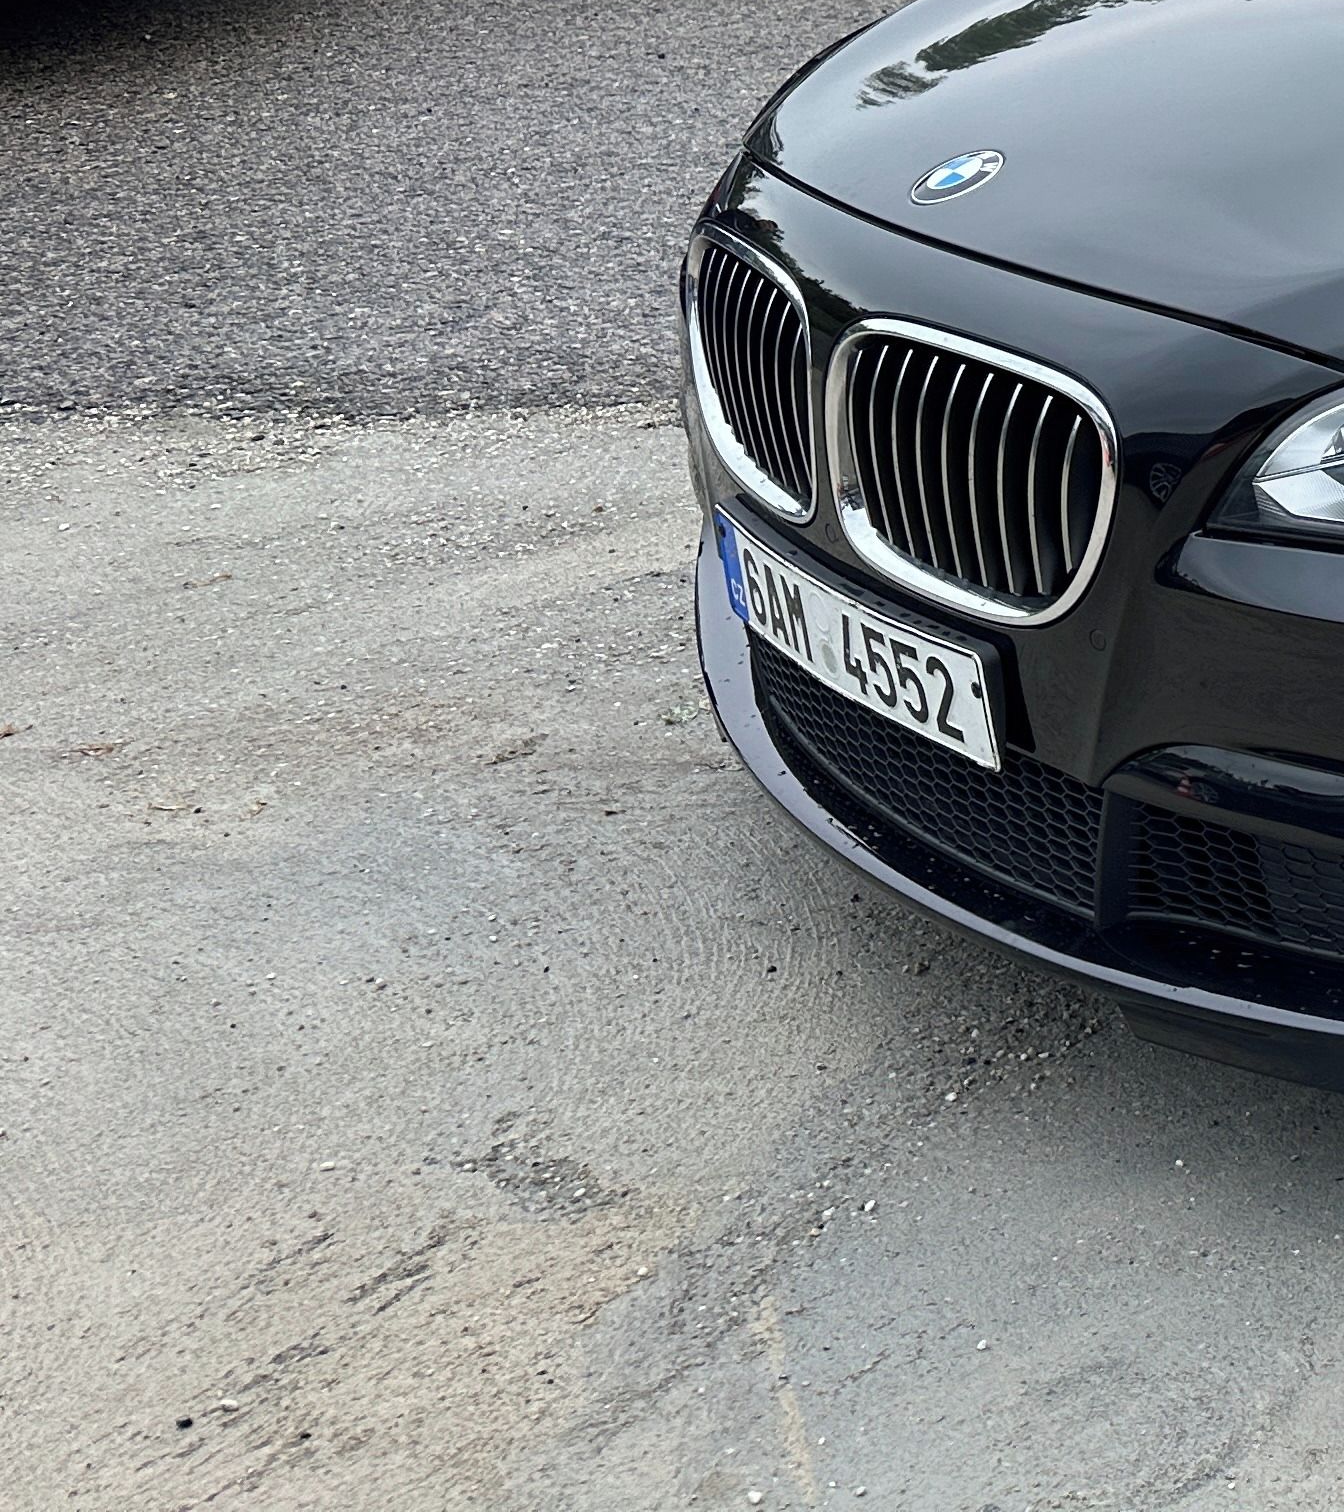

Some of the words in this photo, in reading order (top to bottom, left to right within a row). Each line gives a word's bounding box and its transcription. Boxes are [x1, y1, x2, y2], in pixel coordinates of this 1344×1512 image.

[730, 577, 747, 607] CZ
[743, 548, 814, 664] 6AM
[841, 611, 965, 744] 4552
